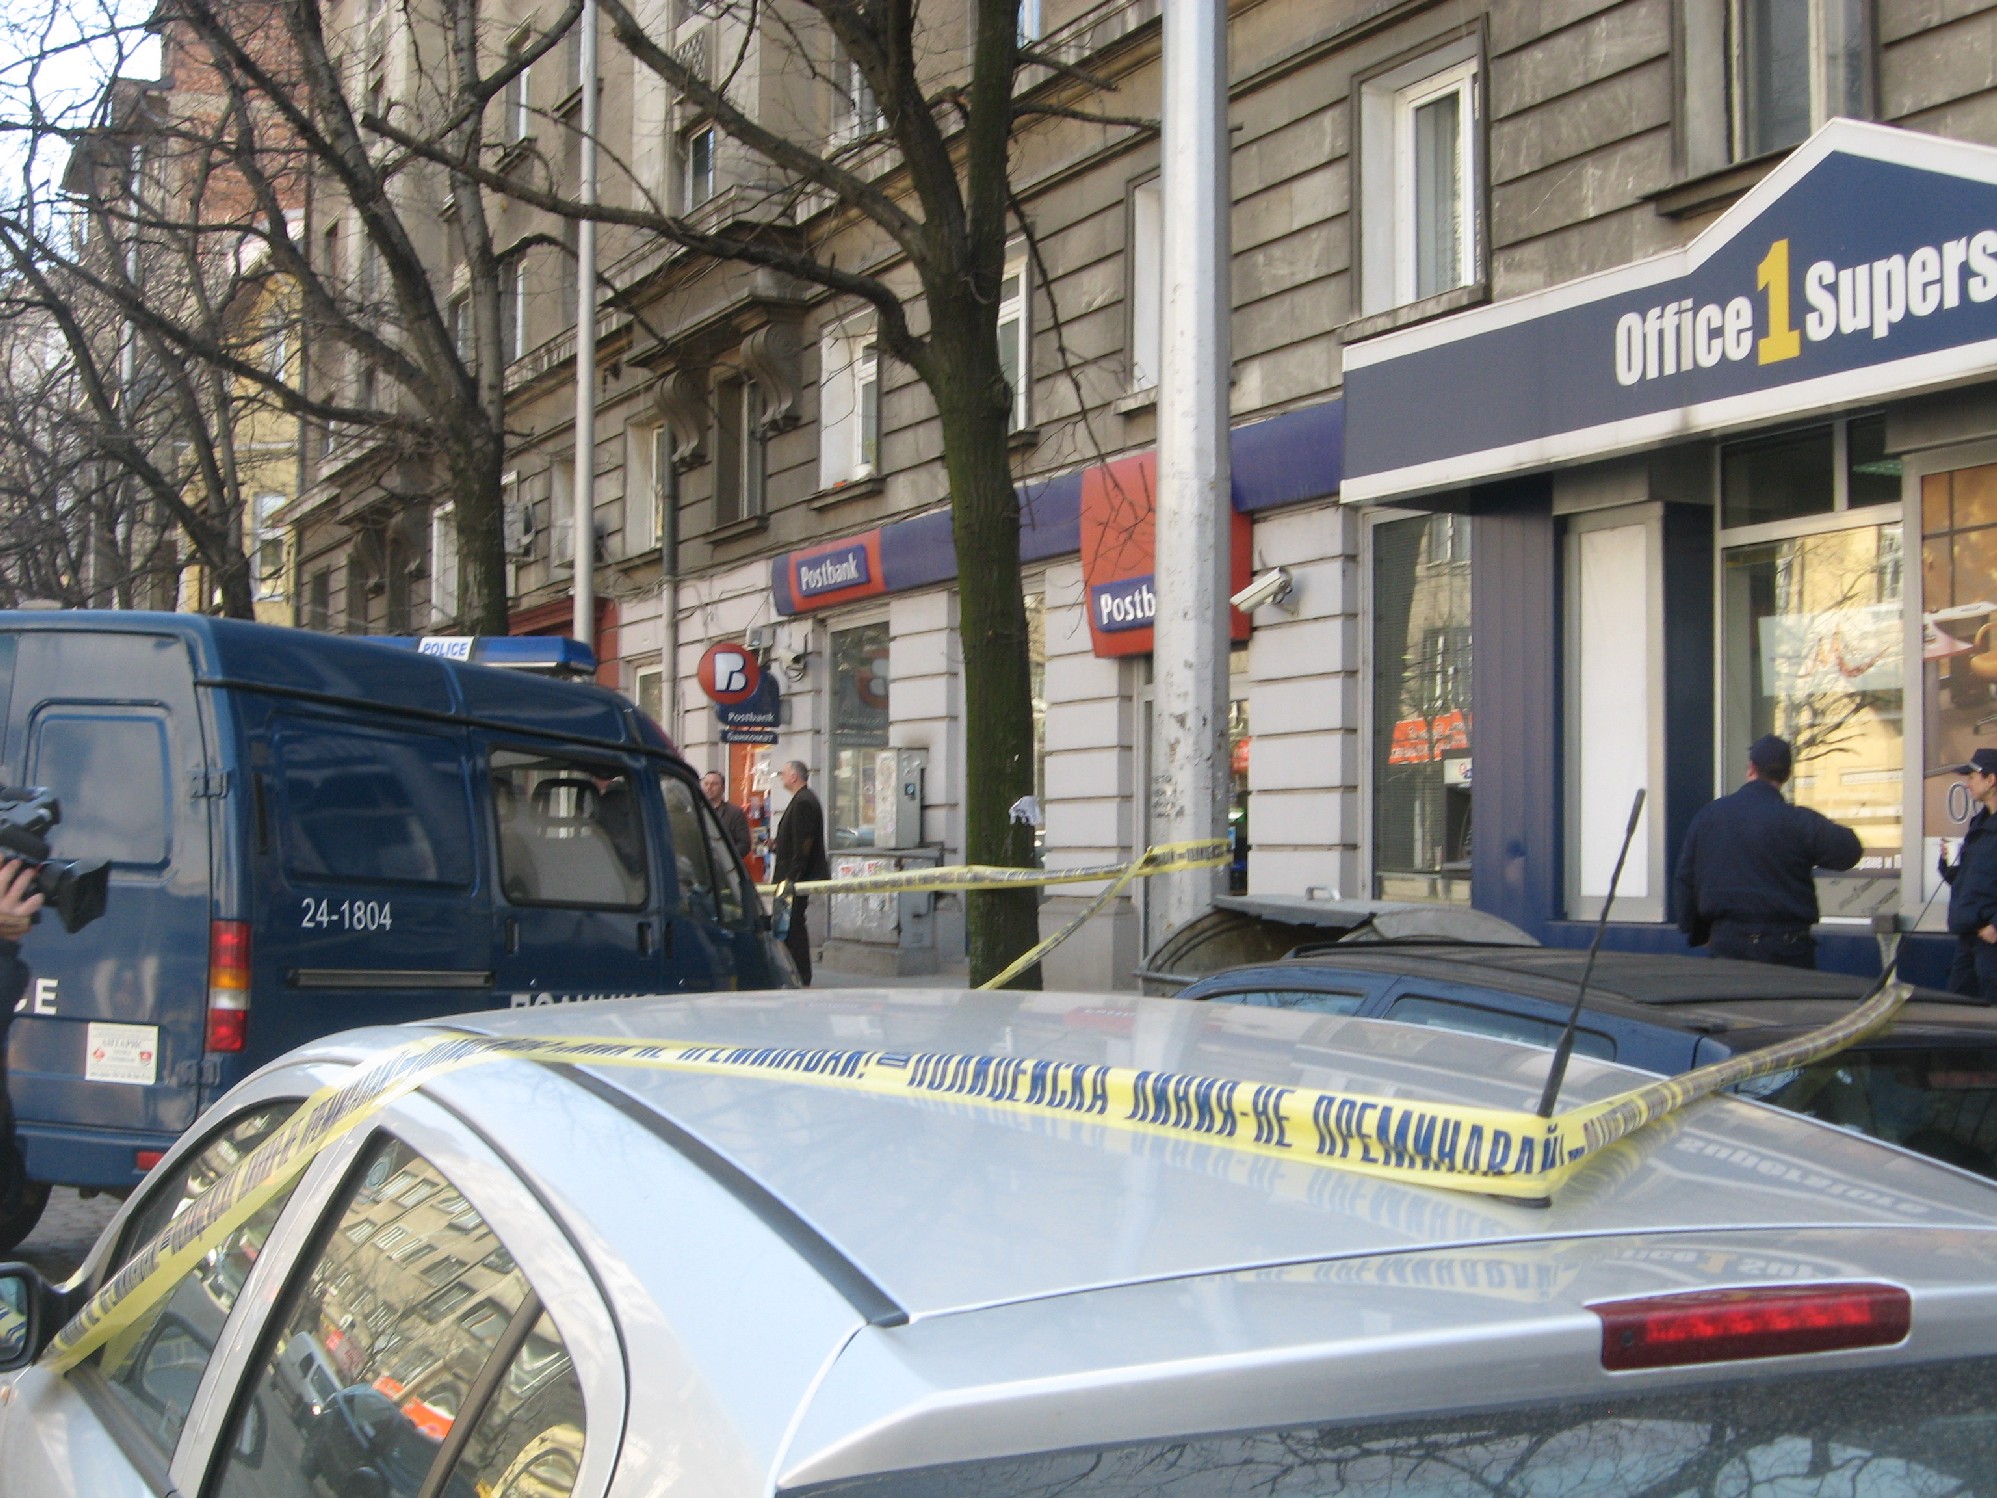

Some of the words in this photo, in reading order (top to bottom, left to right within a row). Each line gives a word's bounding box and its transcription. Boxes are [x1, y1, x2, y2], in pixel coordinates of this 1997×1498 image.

[1615, 296, 1753, 387] Office
[1756, 238, 1801, 366] 1
[1805, 229, 1997, 342] Supers
[801, 552, 859, 591] Postbank
[423, 642, 468, 656] POLICE
[301, 898, 392, 931] 24-1804
